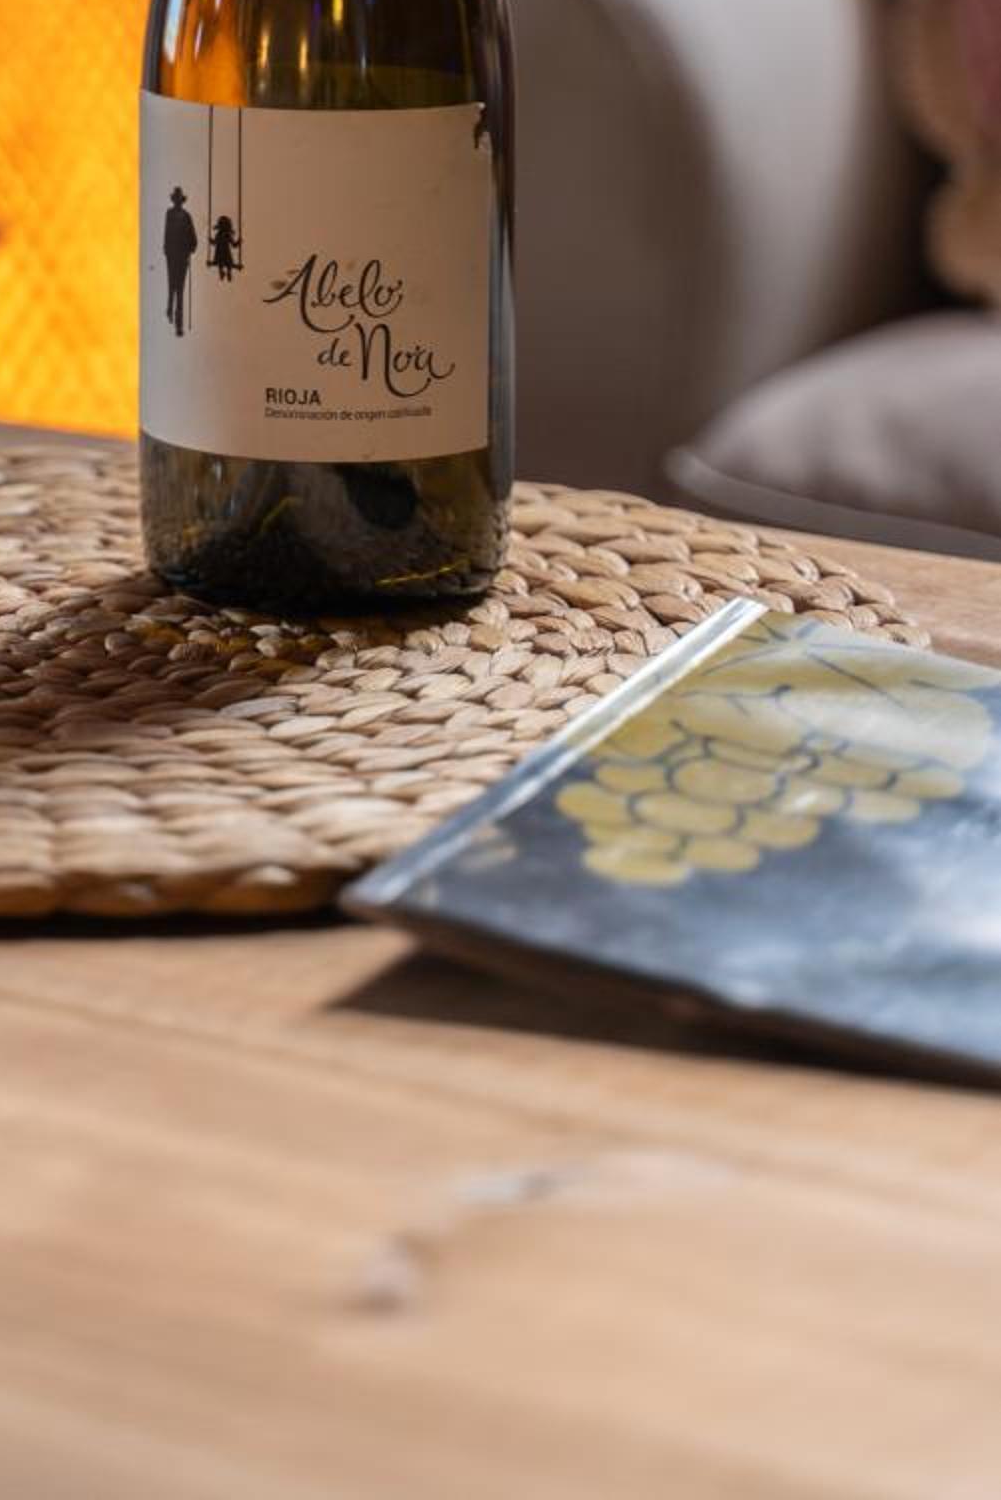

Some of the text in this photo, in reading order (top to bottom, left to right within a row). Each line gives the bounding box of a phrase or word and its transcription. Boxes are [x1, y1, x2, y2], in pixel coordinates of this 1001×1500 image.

[262, 253, 403, 332] Abelo
[316, 338, 351, 367] de
[265, 387, 321, 405] RIOJA
